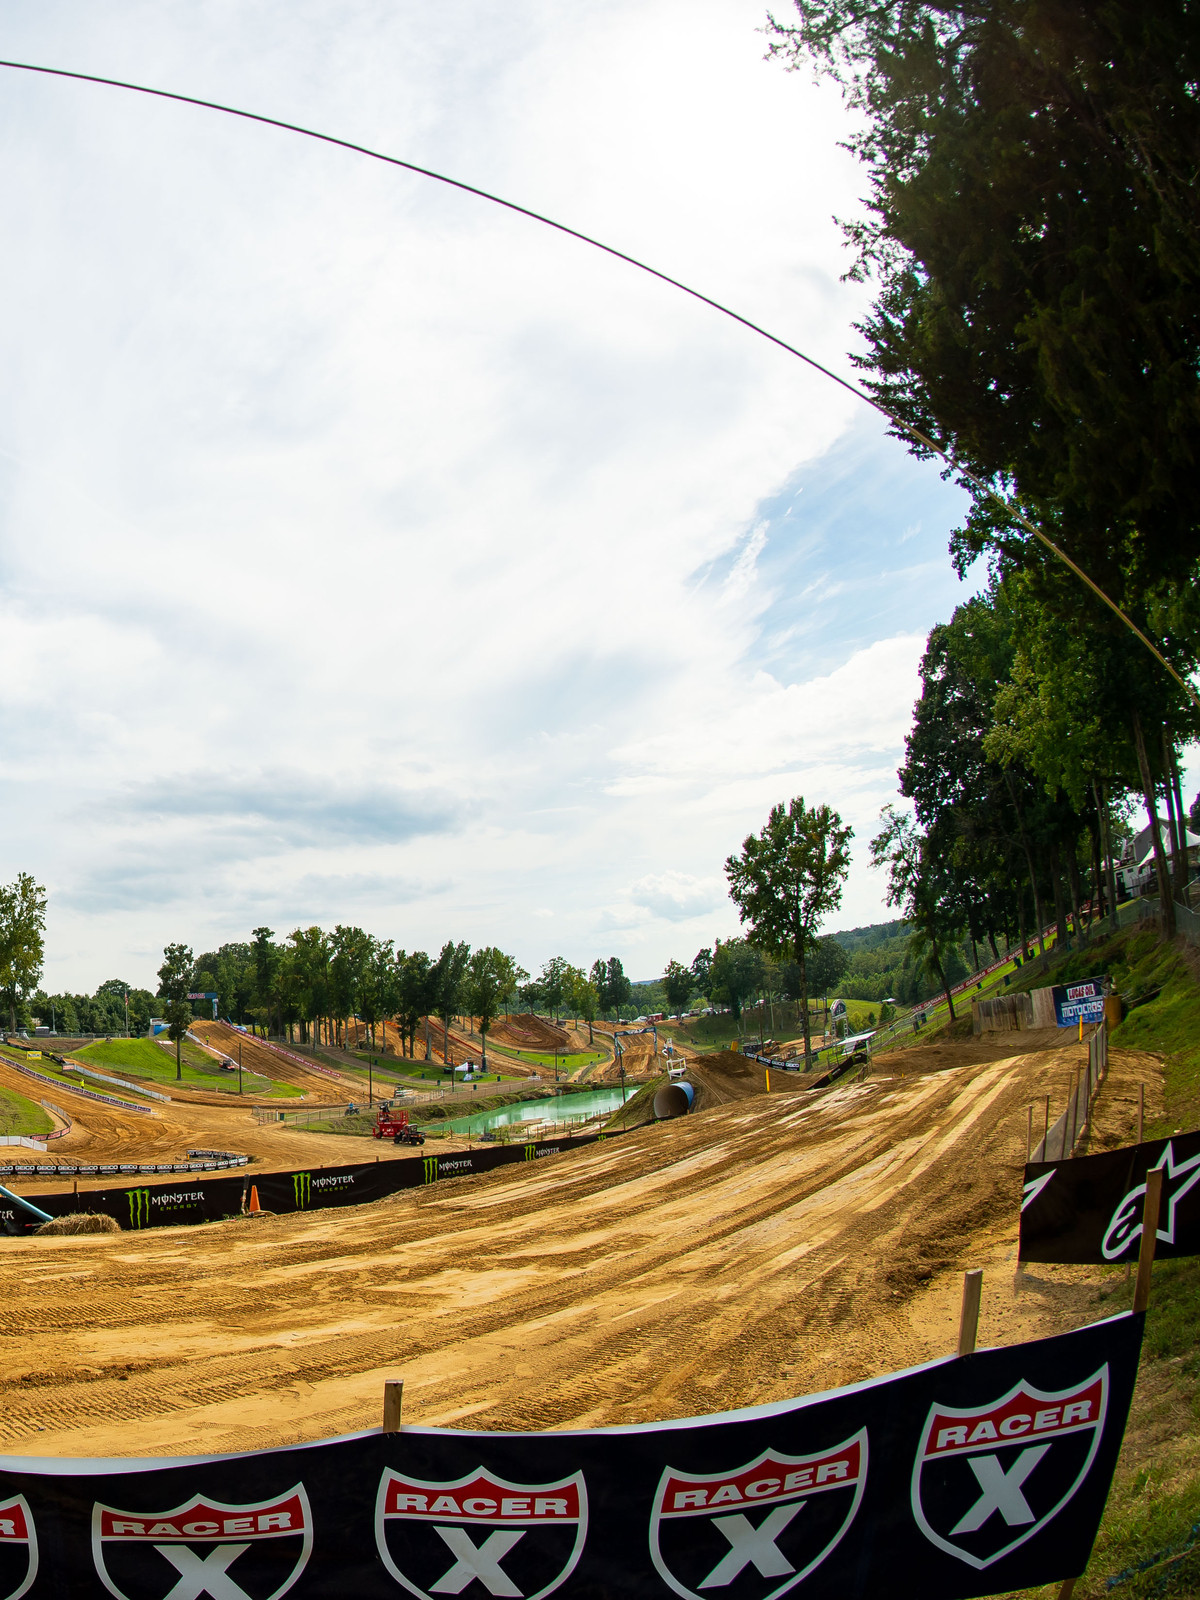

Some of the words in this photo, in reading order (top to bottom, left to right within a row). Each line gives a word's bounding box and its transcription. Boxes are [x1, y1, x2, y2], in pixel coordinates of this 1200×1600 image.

[438, 1159, 473, 1172] MONSTER
[311, 1174, 355, 1188] MONSTER
[318, 1185, 349, 1193] ENERGY
[151, 1191, 205, 1206] MONSTER
[159, 1203, 198, 1212] ENERGY
[936, 1400, 1093, 1449] RACER
[672, 1459, 853, 1510] RACER
[948, 1442, 1054, 1536] X
[395, 1492, 569, 1518] RACER
[110, 1511, 295, 1537] RACER
[696, 1500, 809, 1590] X
[152, 1543, 256, 1600] X
[427, 1525, 528, 1598] X
